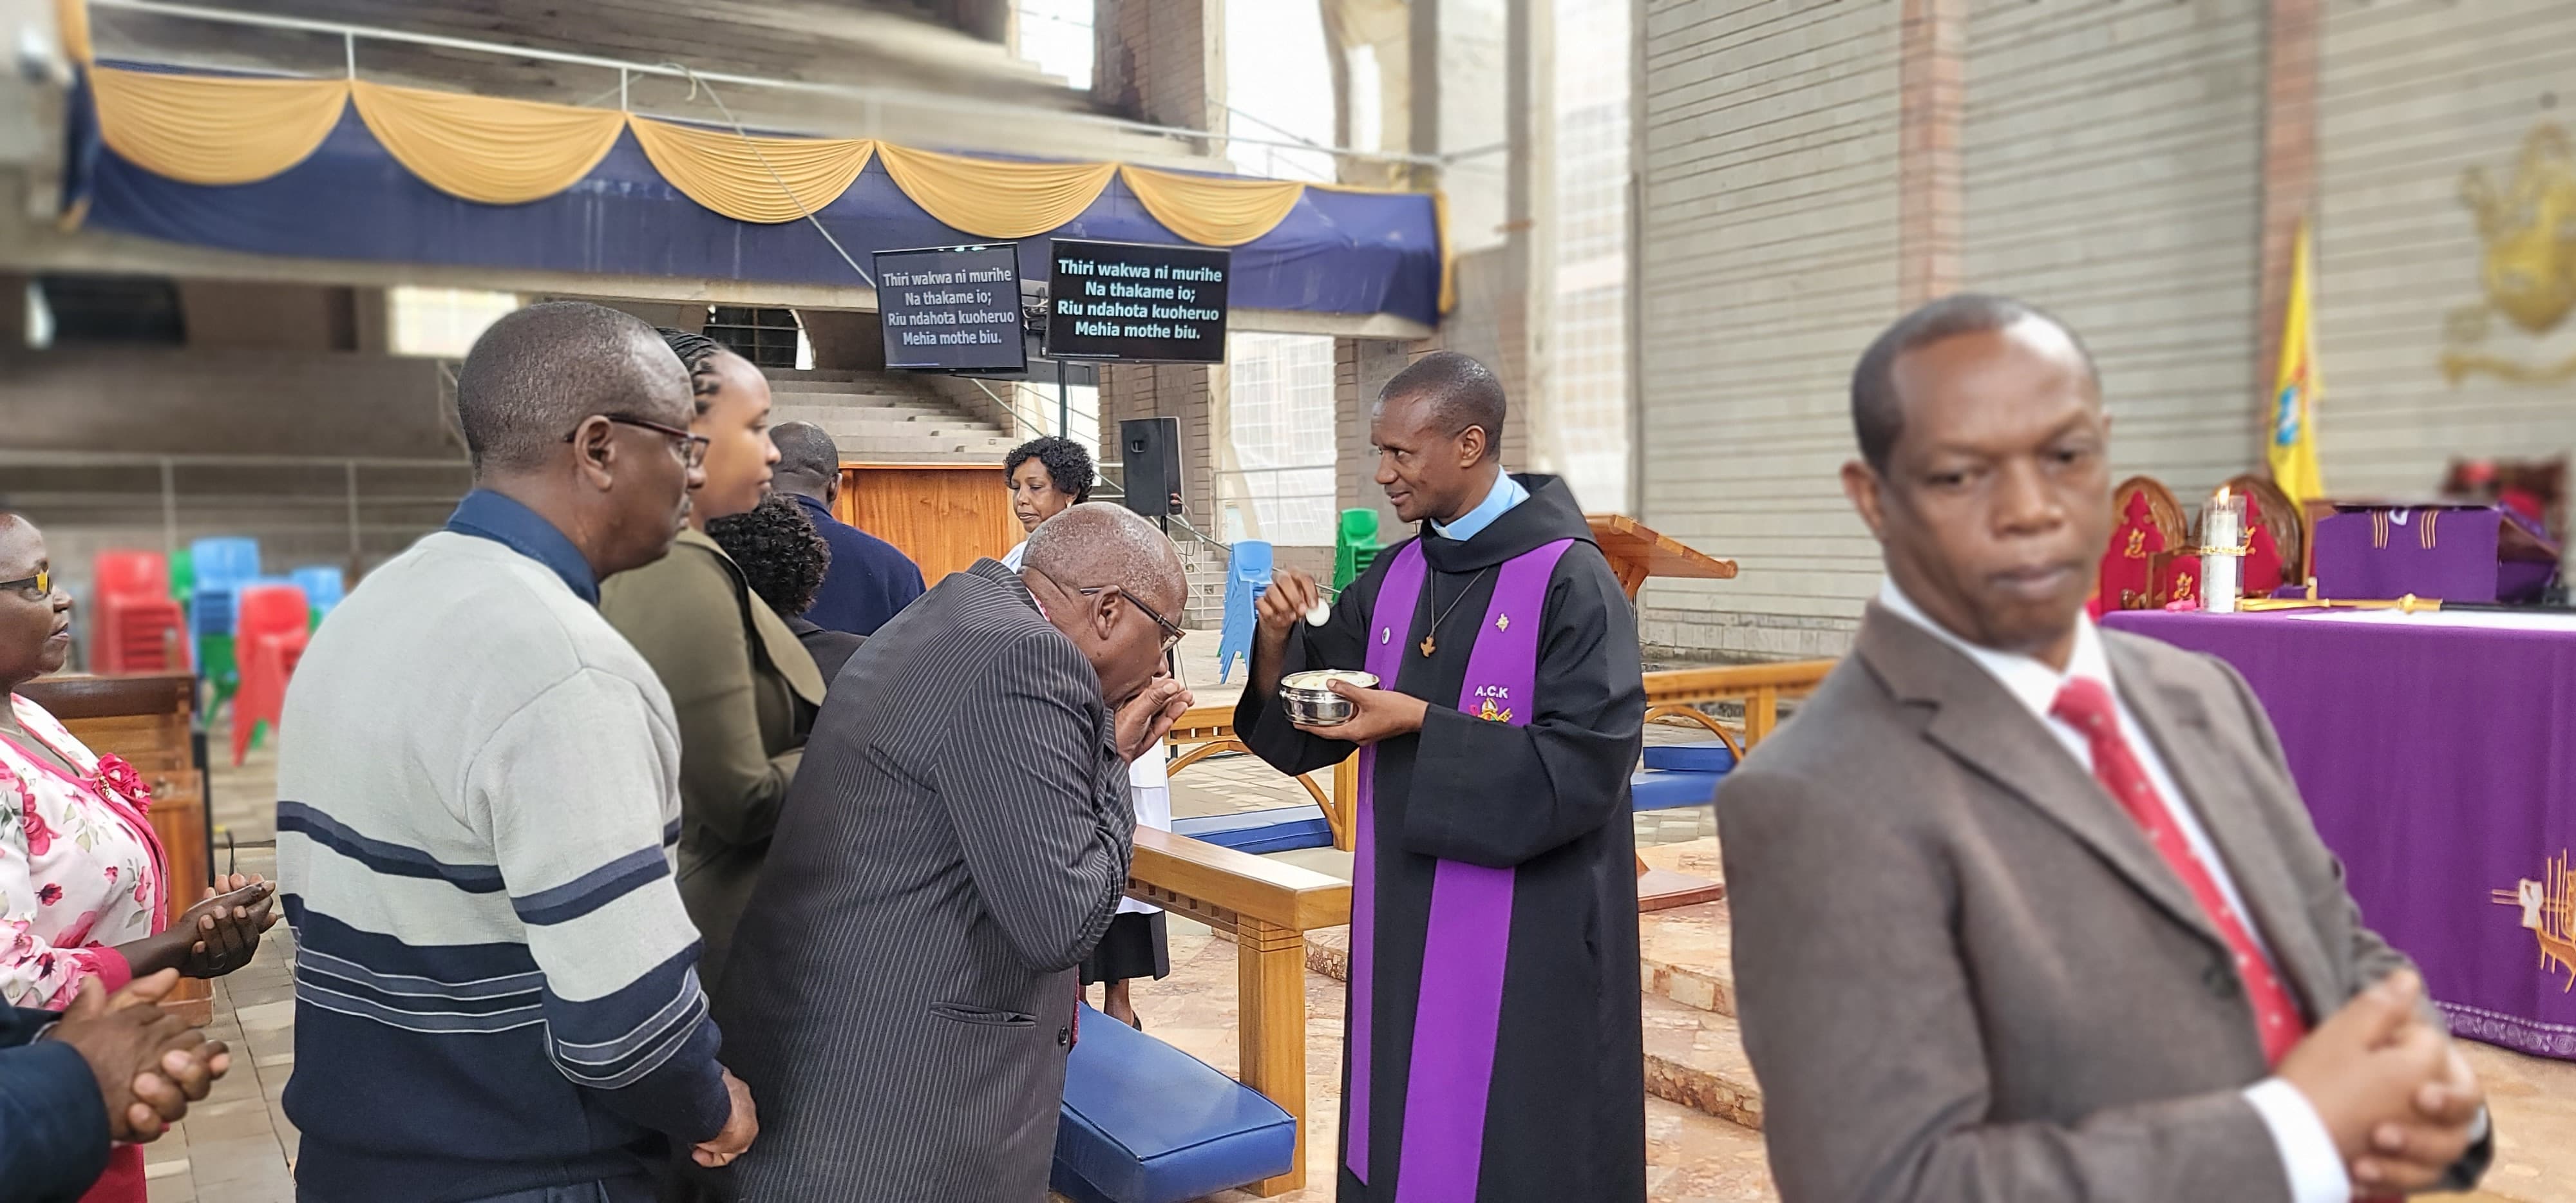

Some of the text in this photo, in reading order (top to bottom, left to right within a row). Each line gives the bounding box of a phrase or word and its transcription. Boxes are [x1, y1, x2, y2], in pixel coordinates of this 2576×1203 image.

[883, 268, 1012, 287] Thiri wakwa ni murihe
[1059, 260, 1222, 282] Thiri wakwa ni murihe
[905, 290, 992, 306] Na thakame io;
[1086, 281, 1195, 303] Na thakame io;
[888, 311, 1014, 326] Riu ndahota kuoheruo
[1058, 301, 1218, 321] Riu ndahota kuoheruo
[903, 330, 1001, 345] Mehia mothe biu.
[1075, 322, 1200, 339] Mehia mothe biu.
[1475, 685, 1508, 699] A.C.K
